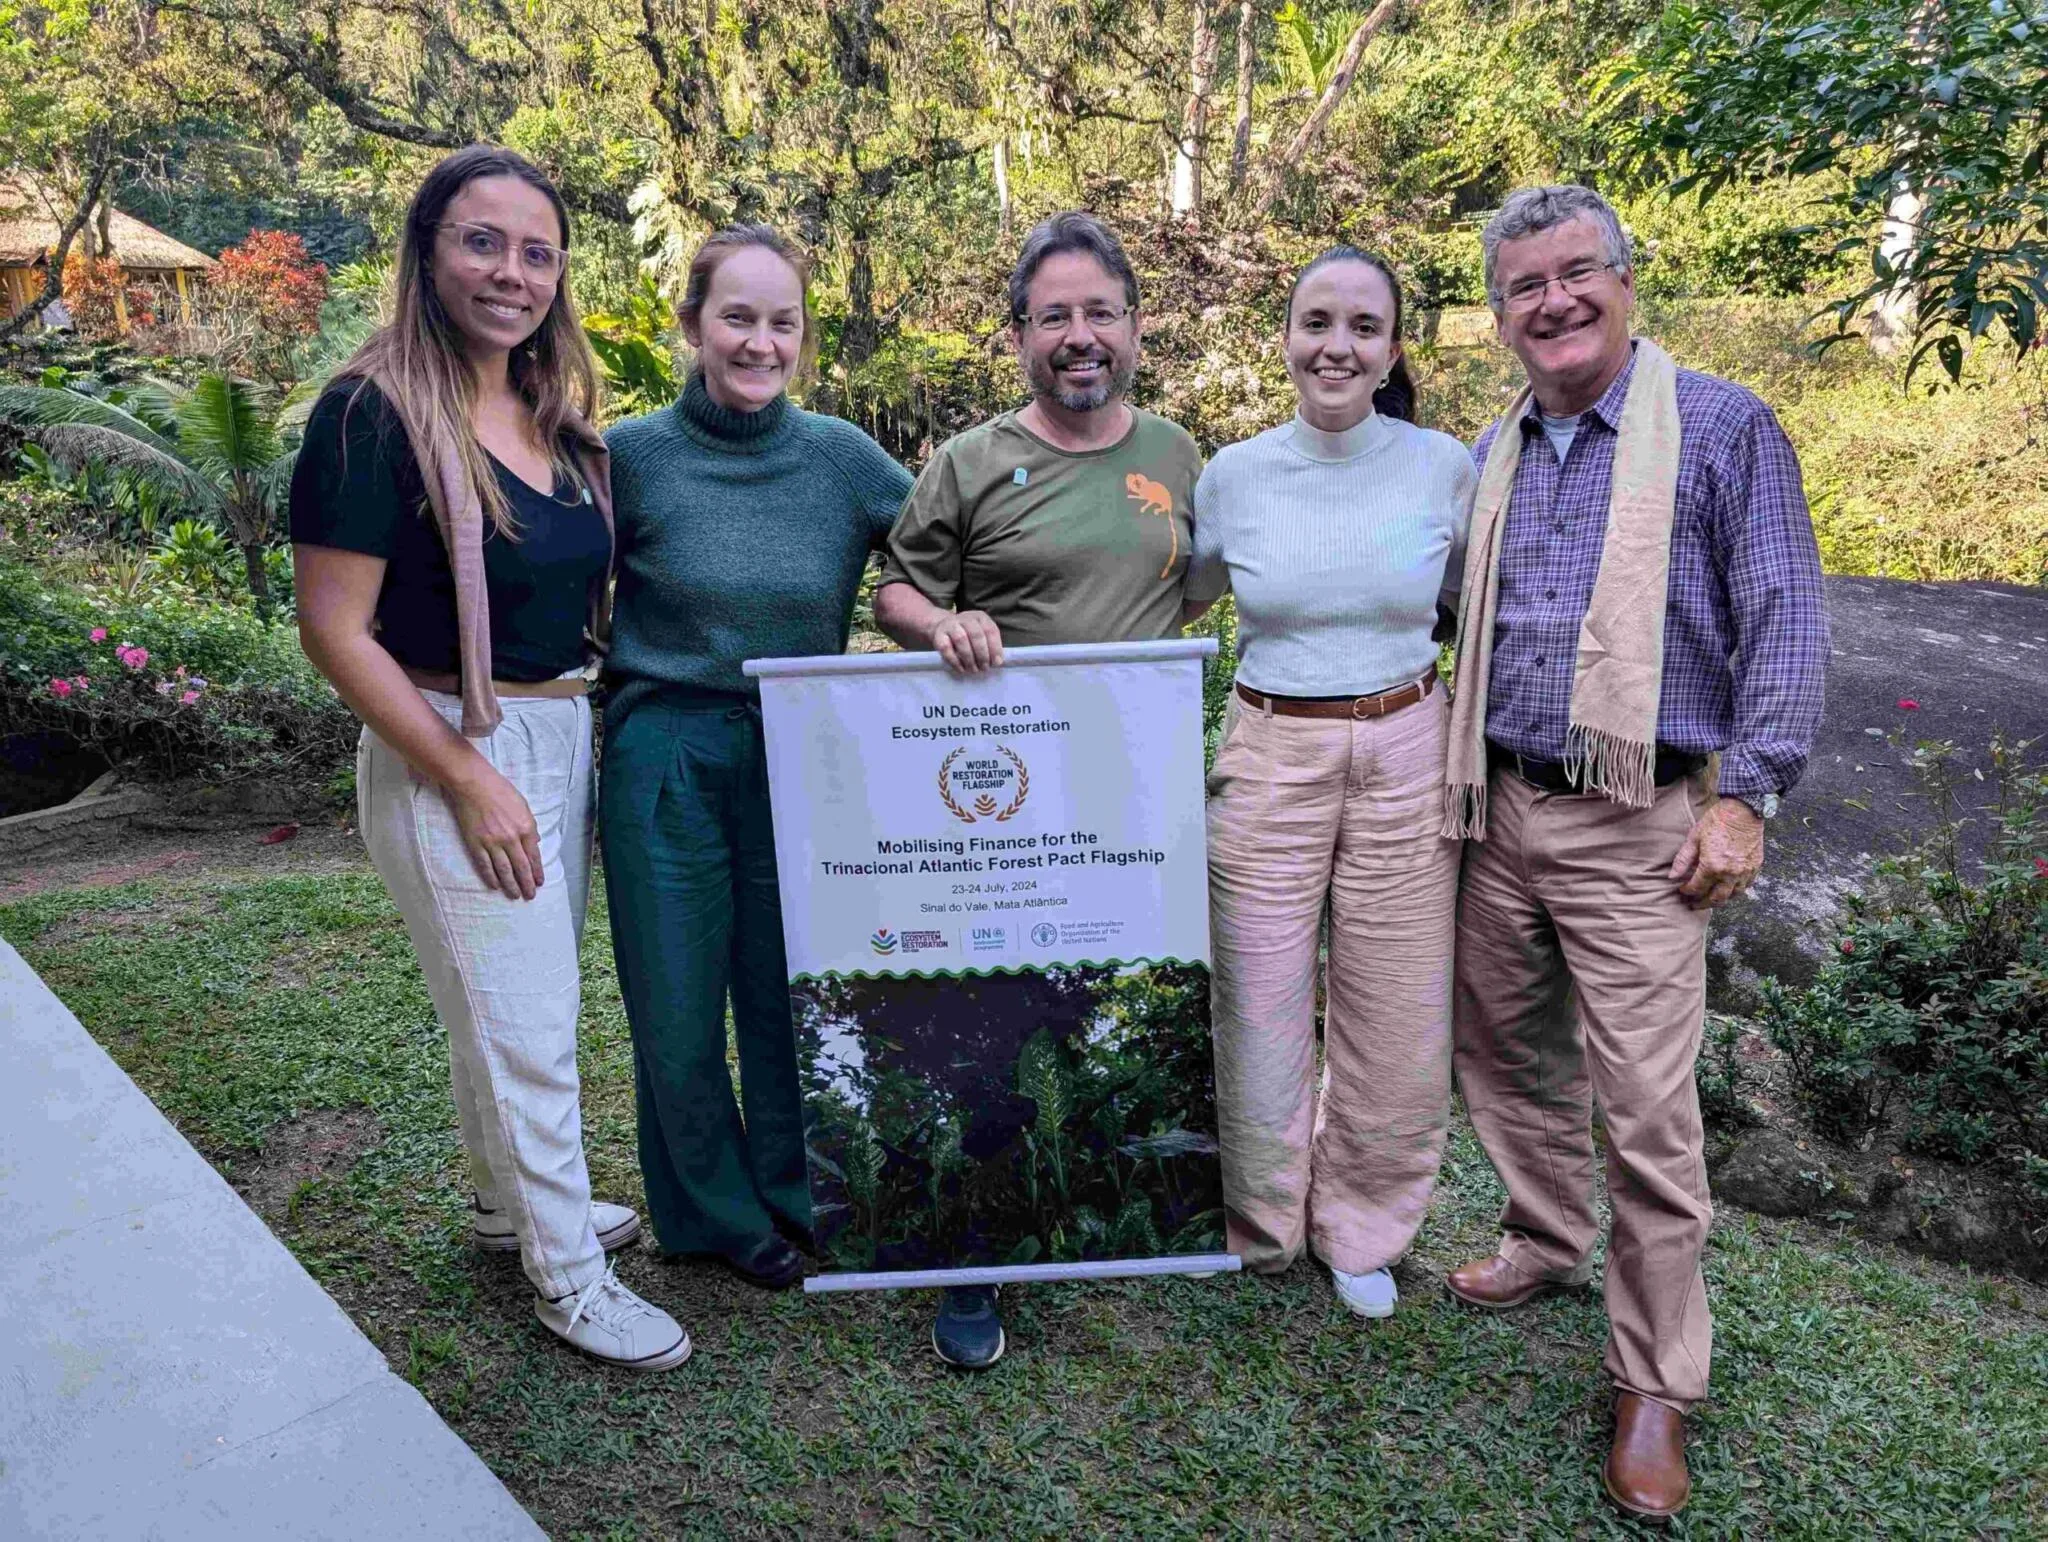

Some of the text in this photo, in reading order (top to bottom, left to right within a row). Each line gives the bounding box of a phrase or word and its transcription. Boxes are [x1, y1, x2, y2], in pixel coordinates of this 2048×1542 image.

[923, 704, 1031, 718] UN Decade on
[892, 720, 1070, 740] Ecosystem Restoration
[966, 760, 998, 770] WORLD
[952, 769, 1013, 780] RESTORATION
[962, 780, 1005, 790] FLAGSHIP
[877, 831, 1098, 855] Mobilising Finance for the
[822, 849, 1165, 875] Trinacional Atlantic Forest Pact Flagship
[951, 880, 1037, 895] 23-24 July, 2024
[920, 896, 1068, 913] Sinal do Vale, Mata Atlântica
[901, 934, 941, 942] ECOSYSTEM
[972, 928, 991, 939] UN
[902, 941, 948, 949] RESTORATION
